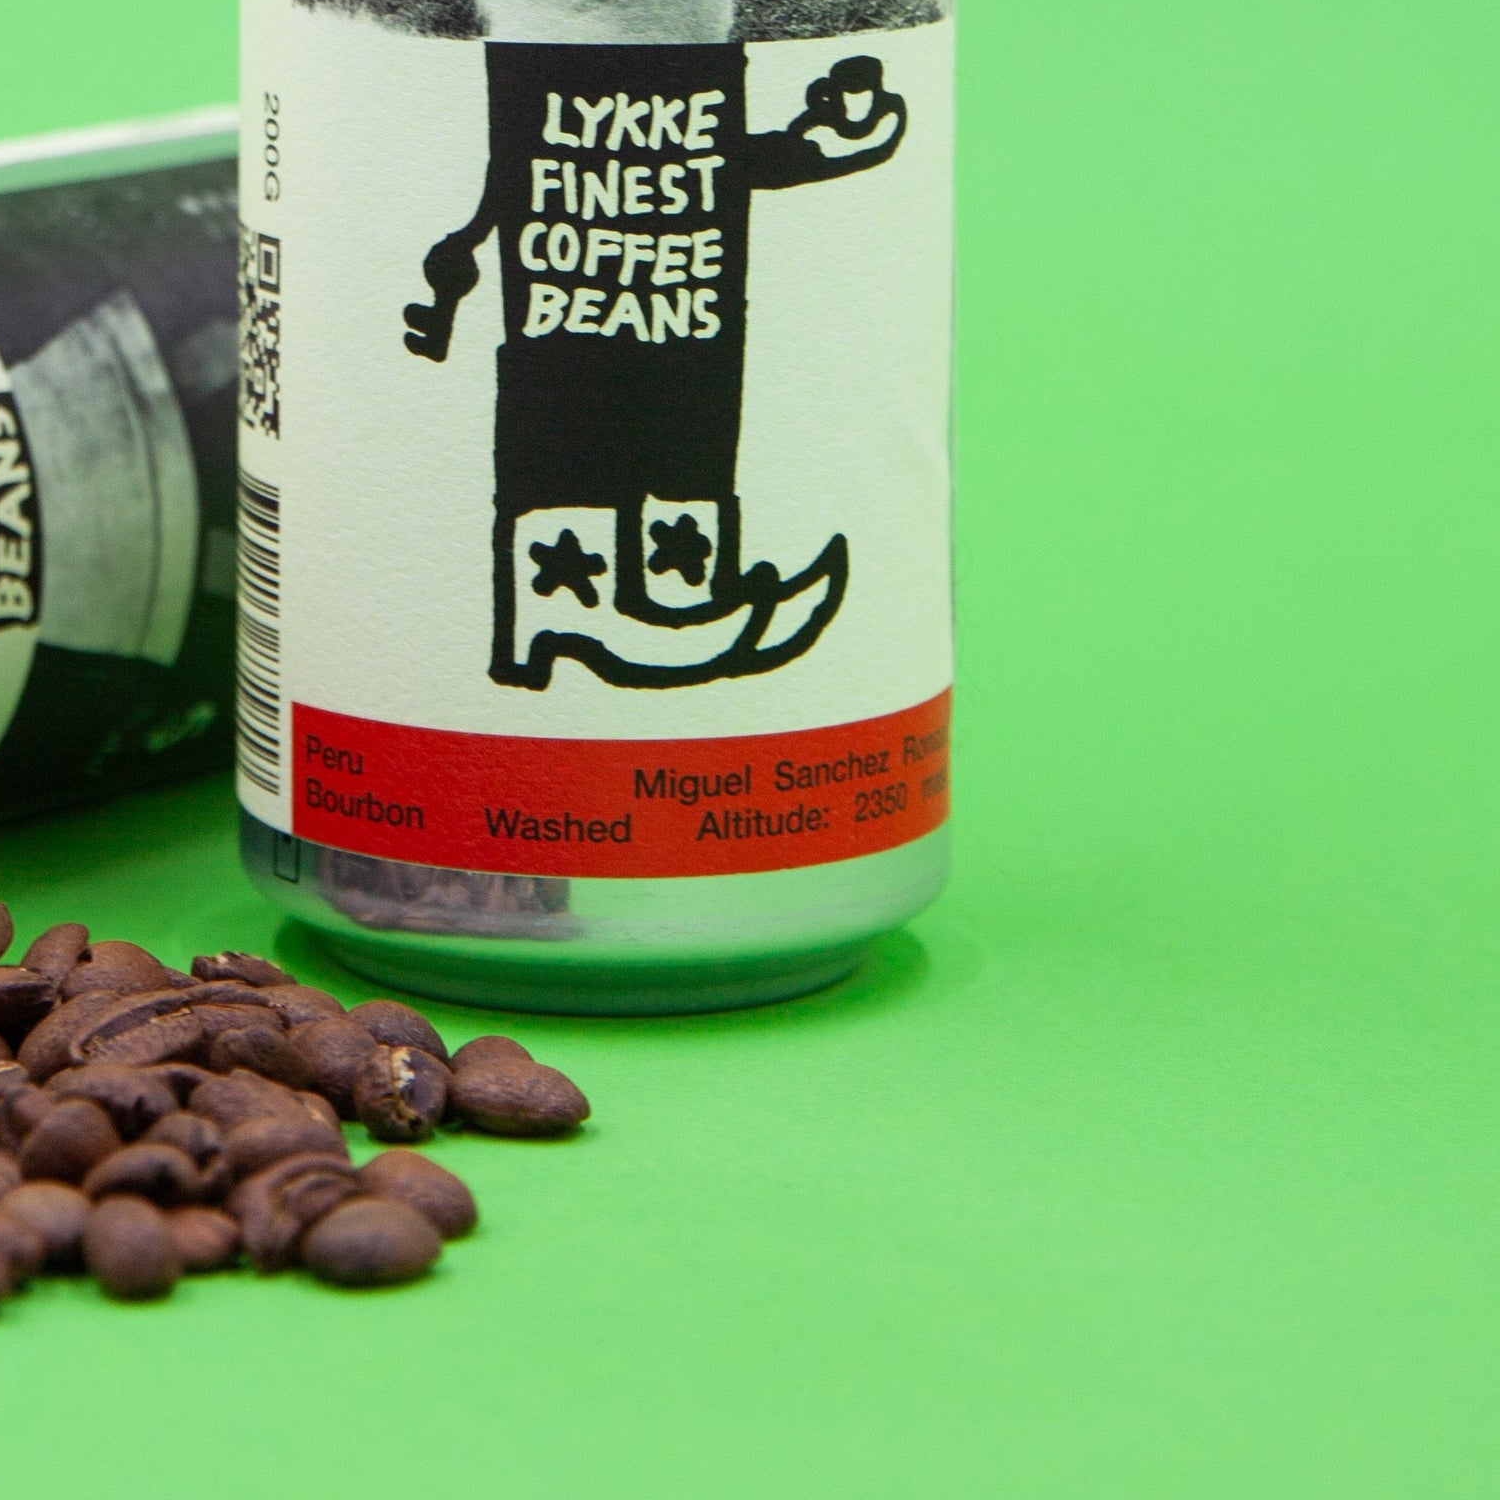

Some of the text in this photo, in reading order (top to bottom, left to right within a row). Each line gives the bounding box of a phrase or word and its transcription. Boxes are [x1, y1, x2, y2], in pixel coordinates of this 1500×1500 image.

[264, 91, 281, 202] 200G
[542, 89, 726, 151] LYKKE
[530, 155, 726, 221] FINEST
[519, 221, 724, 287] COFFEE
[522, 282, 722, 344] BEANS
[305, 734, 364, 776] Peru
[633, 764, 752, 806] Miguel
[773, 749, 891, 792] Sanchez
[305, 777, 426, 830] Bourbon
[484, 806, 633, 844] Washed
[696, 803, 831, 842] Altitude:
[853, 781, 908, 823] 2350
